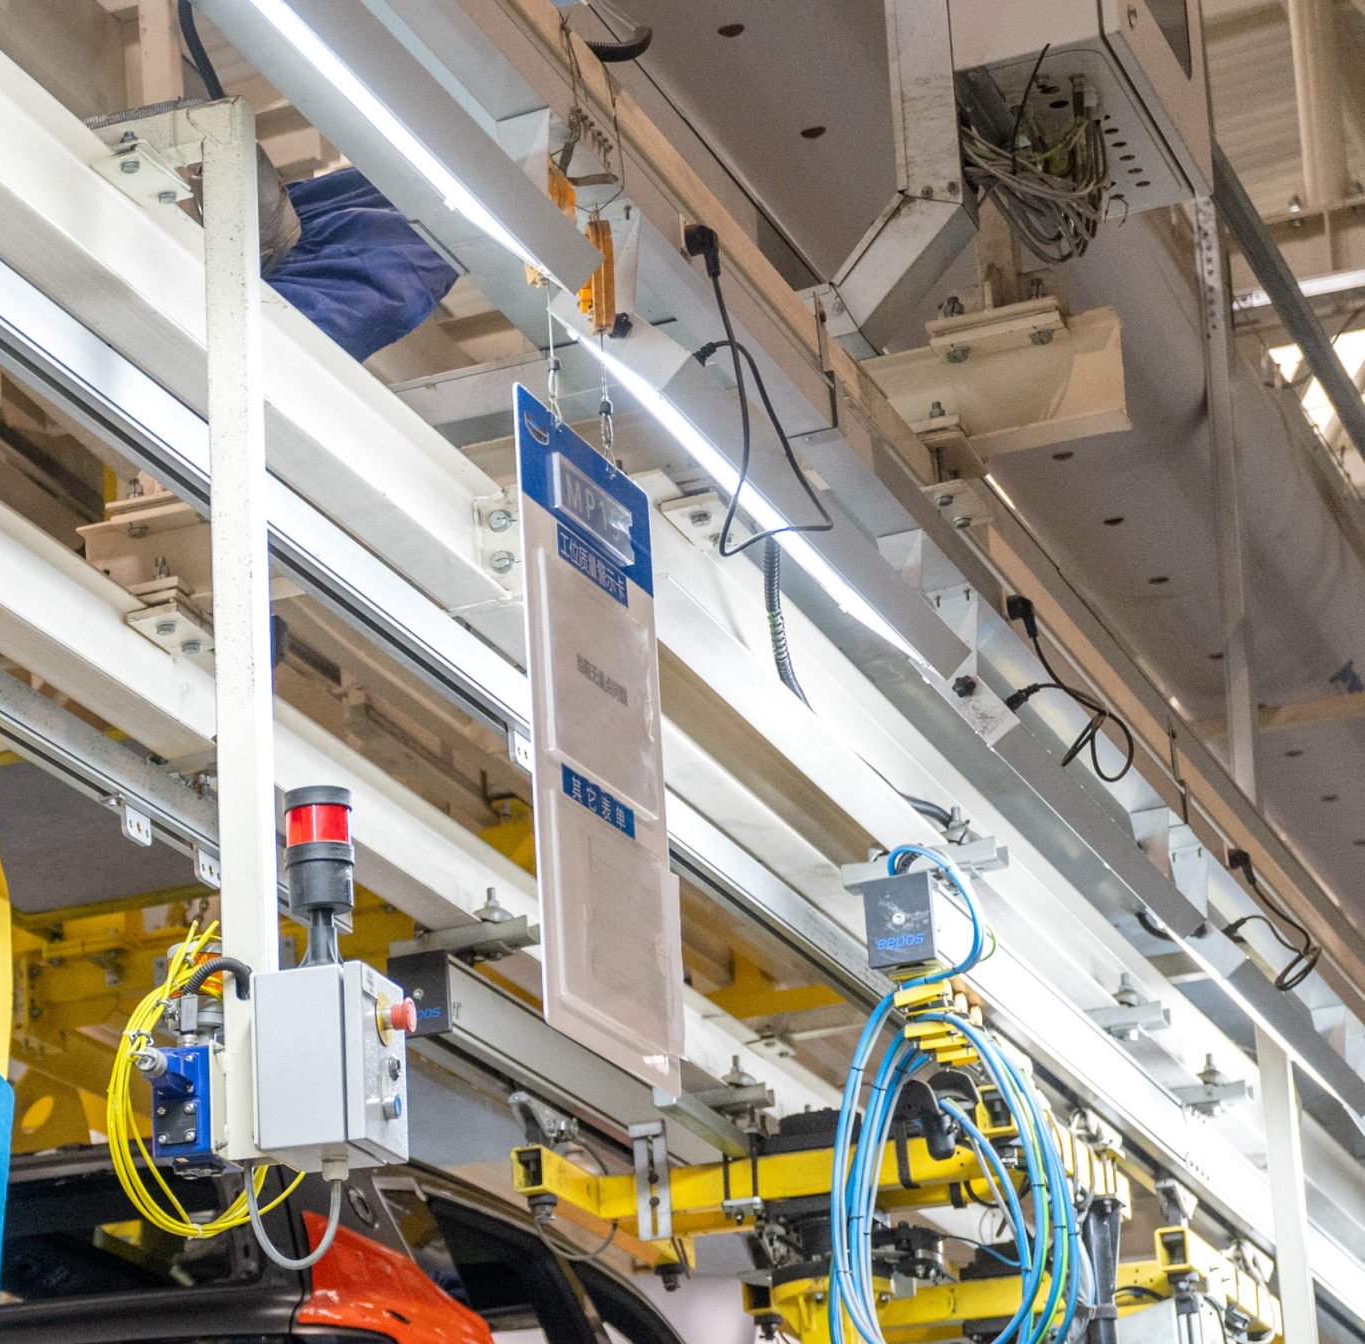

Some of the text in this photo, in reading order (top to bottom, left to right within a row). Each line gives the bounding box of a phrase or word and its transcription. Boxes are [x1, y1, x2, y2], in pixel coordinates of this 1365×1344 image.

[572, 775, 627, 830] 其它表单
[877, 932, 926, 952] eepos
